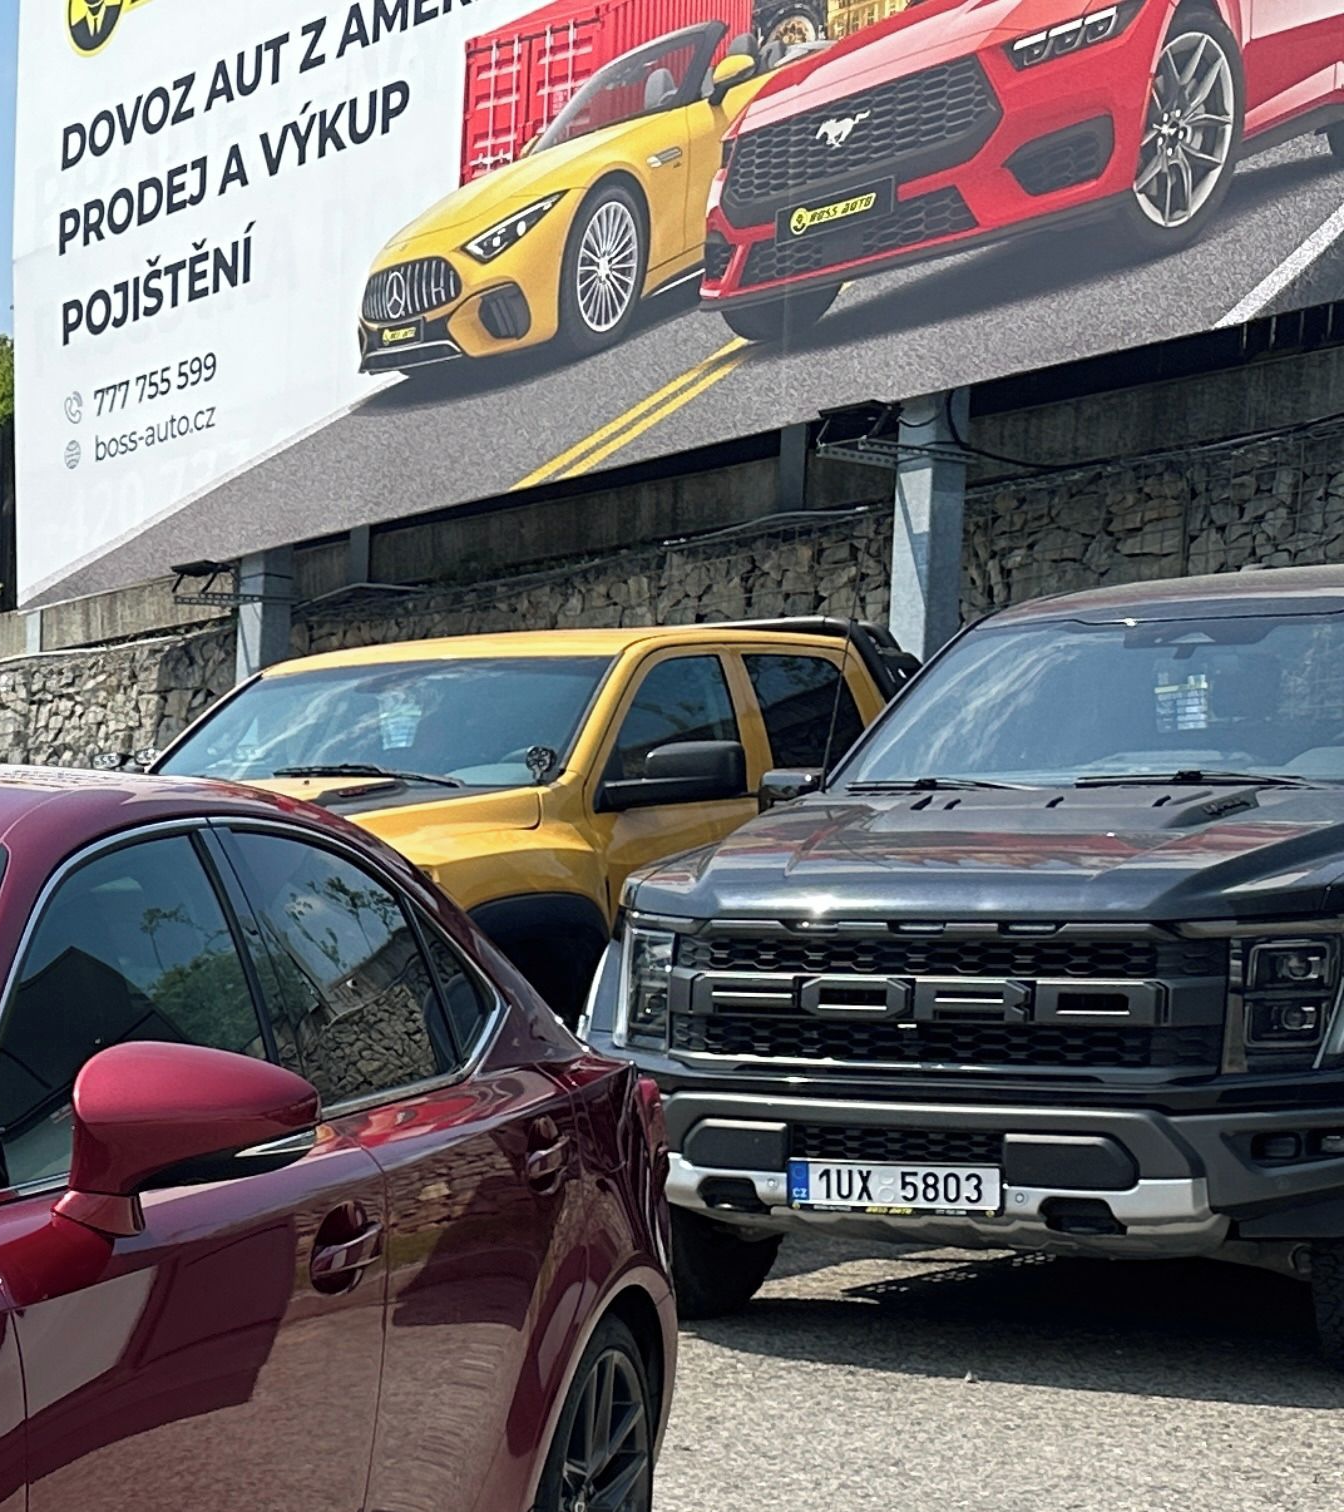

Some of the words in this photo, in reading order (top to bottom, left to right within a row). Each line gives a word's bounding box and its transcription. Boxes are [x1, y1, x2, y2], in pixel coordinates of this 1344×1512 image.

[61, 72, 196, 171] DOVOZ
[204, 32, 290, 113] AUT
[298, 16, 326, 74] Z
[336, 0, 485, 59] AME
[58, 155, 208, 257] PRODEJ
[217, 143, 249, 196] A
[259, 80, 410, 178] VÝKUP
[62, 220, 256, 346] POJIŠTĚNÍ
[93, 380, 131, 416] 777
[134, 366, 171, 404] 755
[176, 352, 217, 390] 599
[94, 406, 217, 462] boss-auto.cz
[690, 972, 1168, 1027] FORD
[792, 1188, 808, 1198] CZ
[819, 1168, 873, 1202] 1UX
[900, 1171, 983, 1204] 5803
